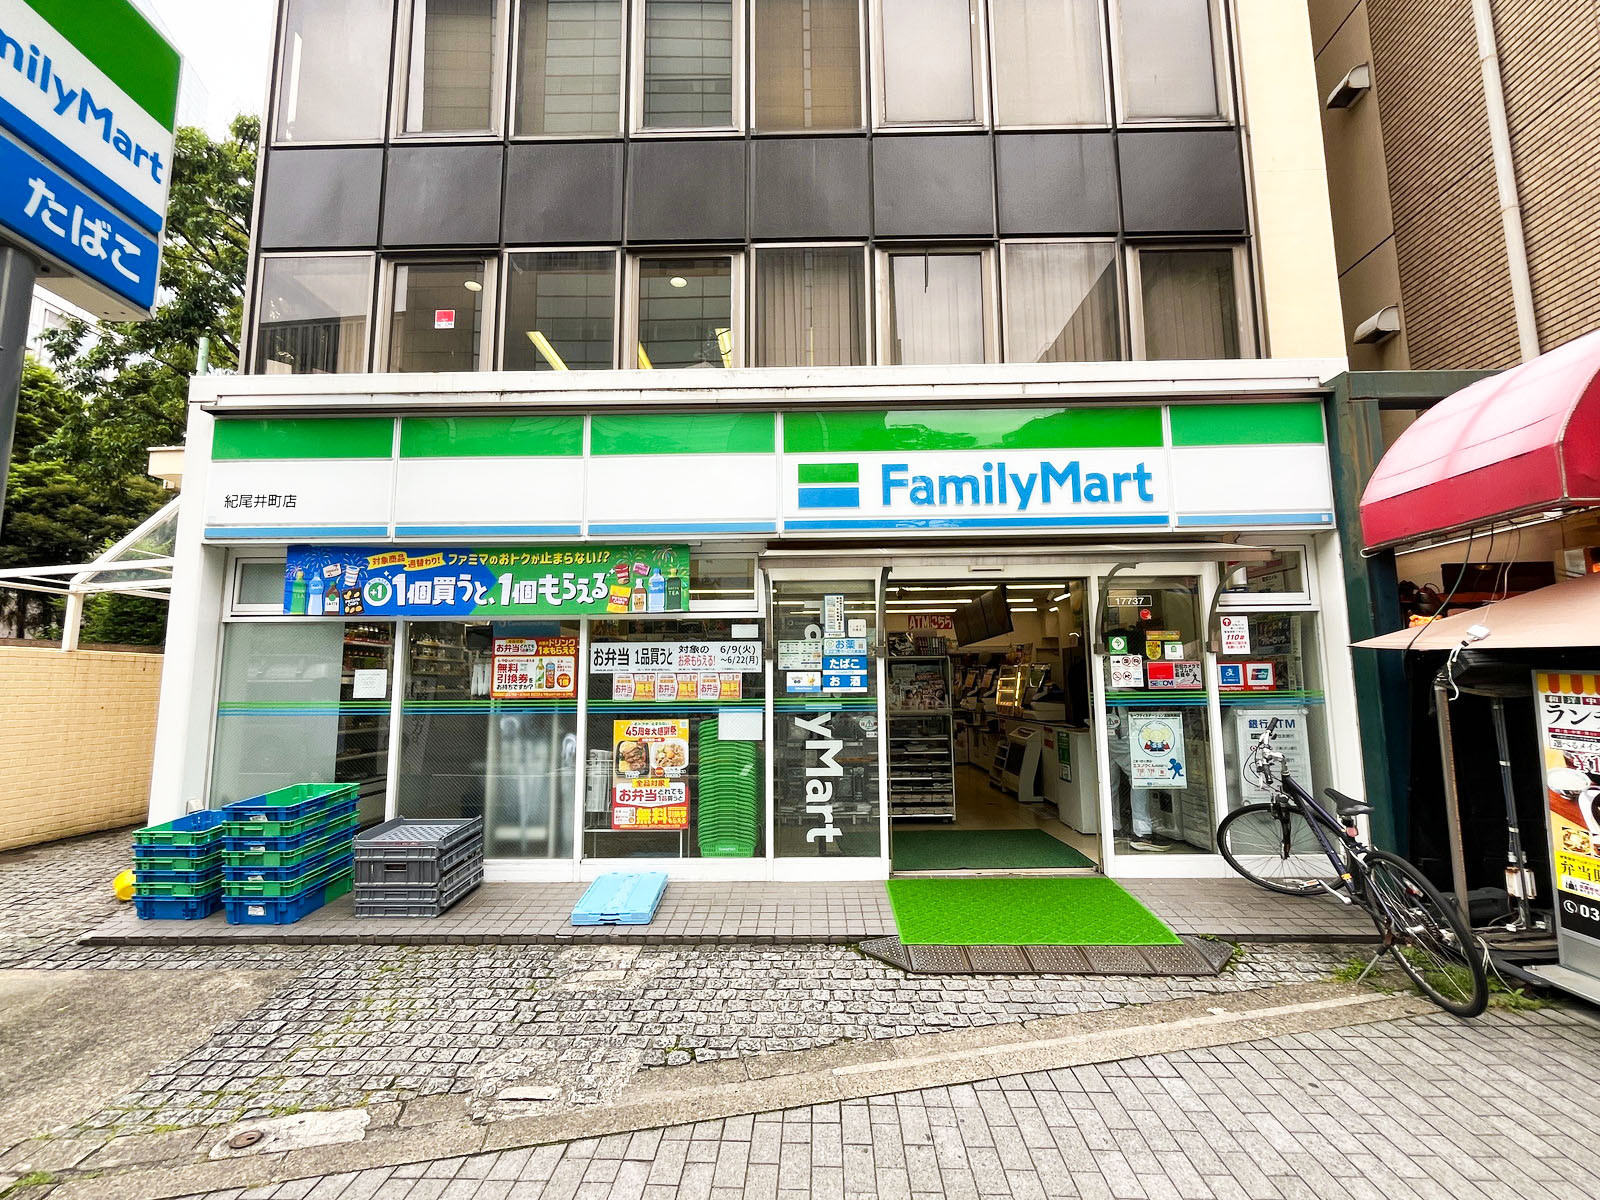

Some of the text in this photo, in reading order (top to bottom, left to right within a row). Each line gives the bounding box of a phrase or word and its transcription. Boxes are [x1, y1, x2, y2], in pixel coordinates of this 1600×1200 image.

[24, 177, 141, 284] たばこ
[881, 460, 1154, 511] FamilyMart
[224, 494, 297, 509] 紀尾井町店
[1115, 597, 1145, 605] 17737
[496, 644, 519, 652] お弁当
[549, 639, 576, 647] ドリンク
[538, 647, 576, 655] 1本もらえる
[678, 645, 709, 654] 対象の
[720, 645, 756, 655] 6/9(火)
[593, 647, 629, 666] お弁当
[635, 647, 673, 665] 1品買うと
[678, 655, 716, 666] お茶もらえる!
[497, 663, 518, 673] 無料
[829, 658, 860, 669] たばこ
[615, 684, 633, 693] お弁当
[658, 684, 676, 693] お弁当
[701, 684, 718, 693] お弁当
[1547, 705, 1600, 726] ラン
[619, 789, 657, 802] お弁当
[1579, 904, 1600, 922] 03
